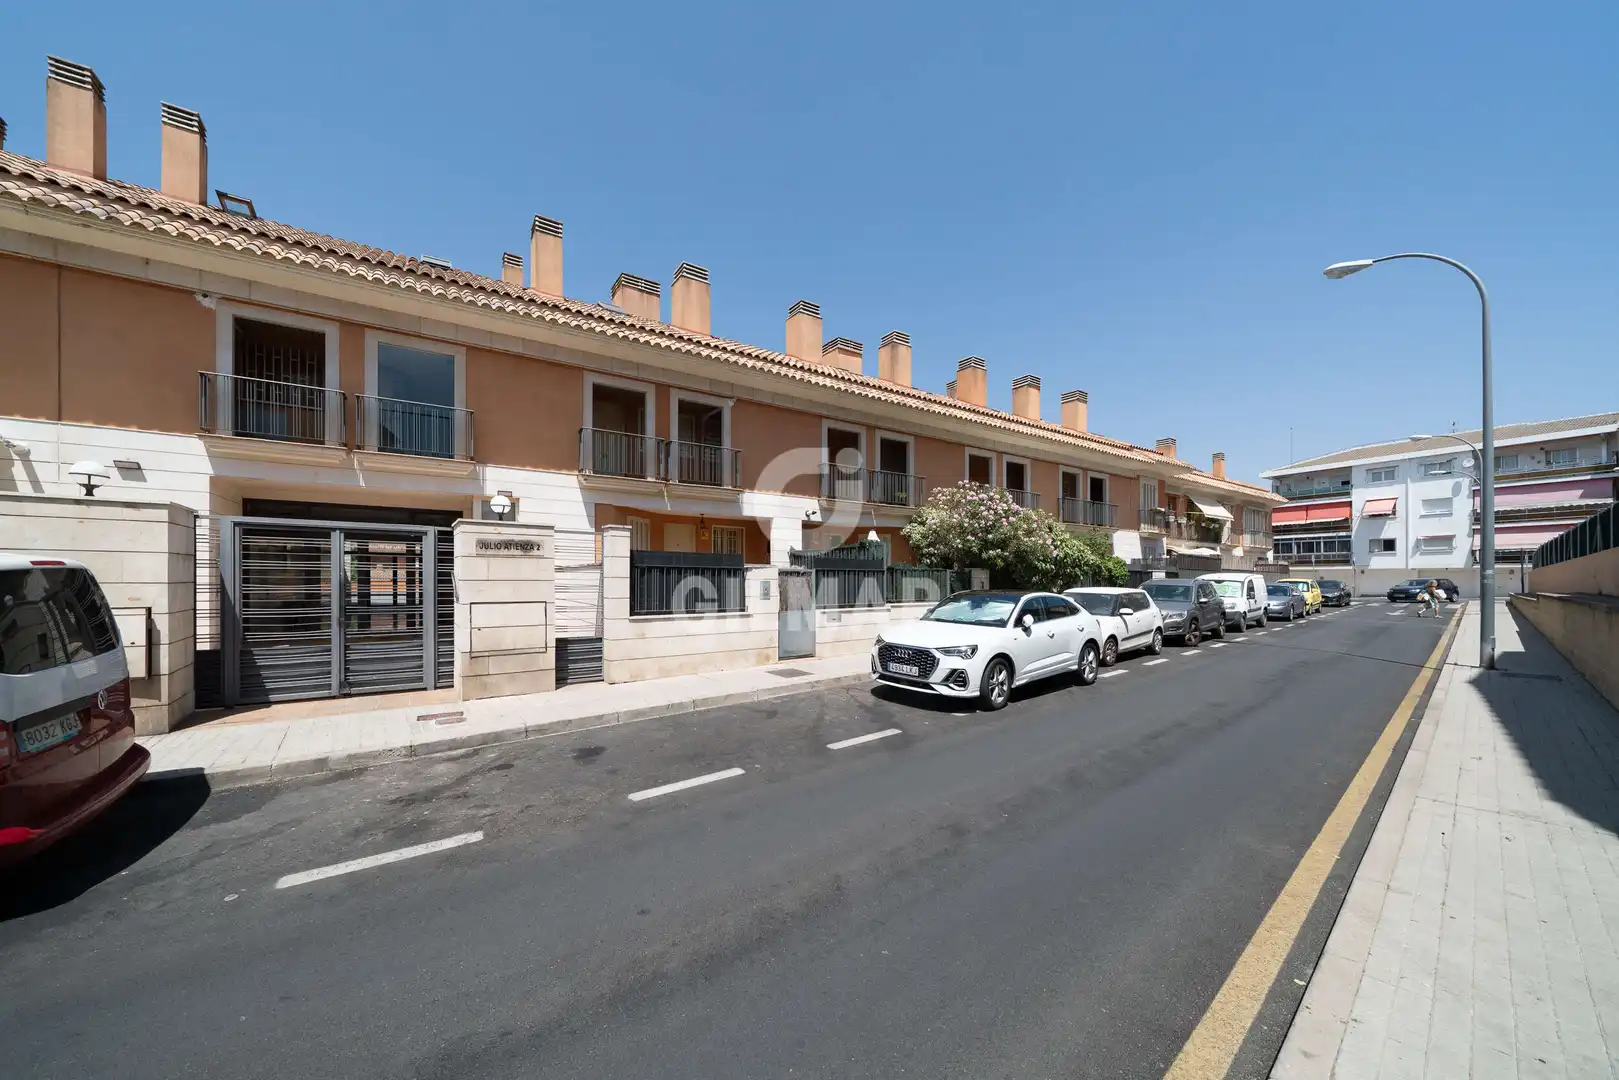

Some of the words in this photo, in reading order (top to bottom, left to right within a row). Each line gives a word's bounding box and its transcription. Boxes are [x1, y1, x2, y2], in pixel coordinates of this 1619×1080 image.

[480, 542, 502, 550] JULIO
[503, 542, 535, 551] ATIENZA
[24, 723, 58, 746] 8032
